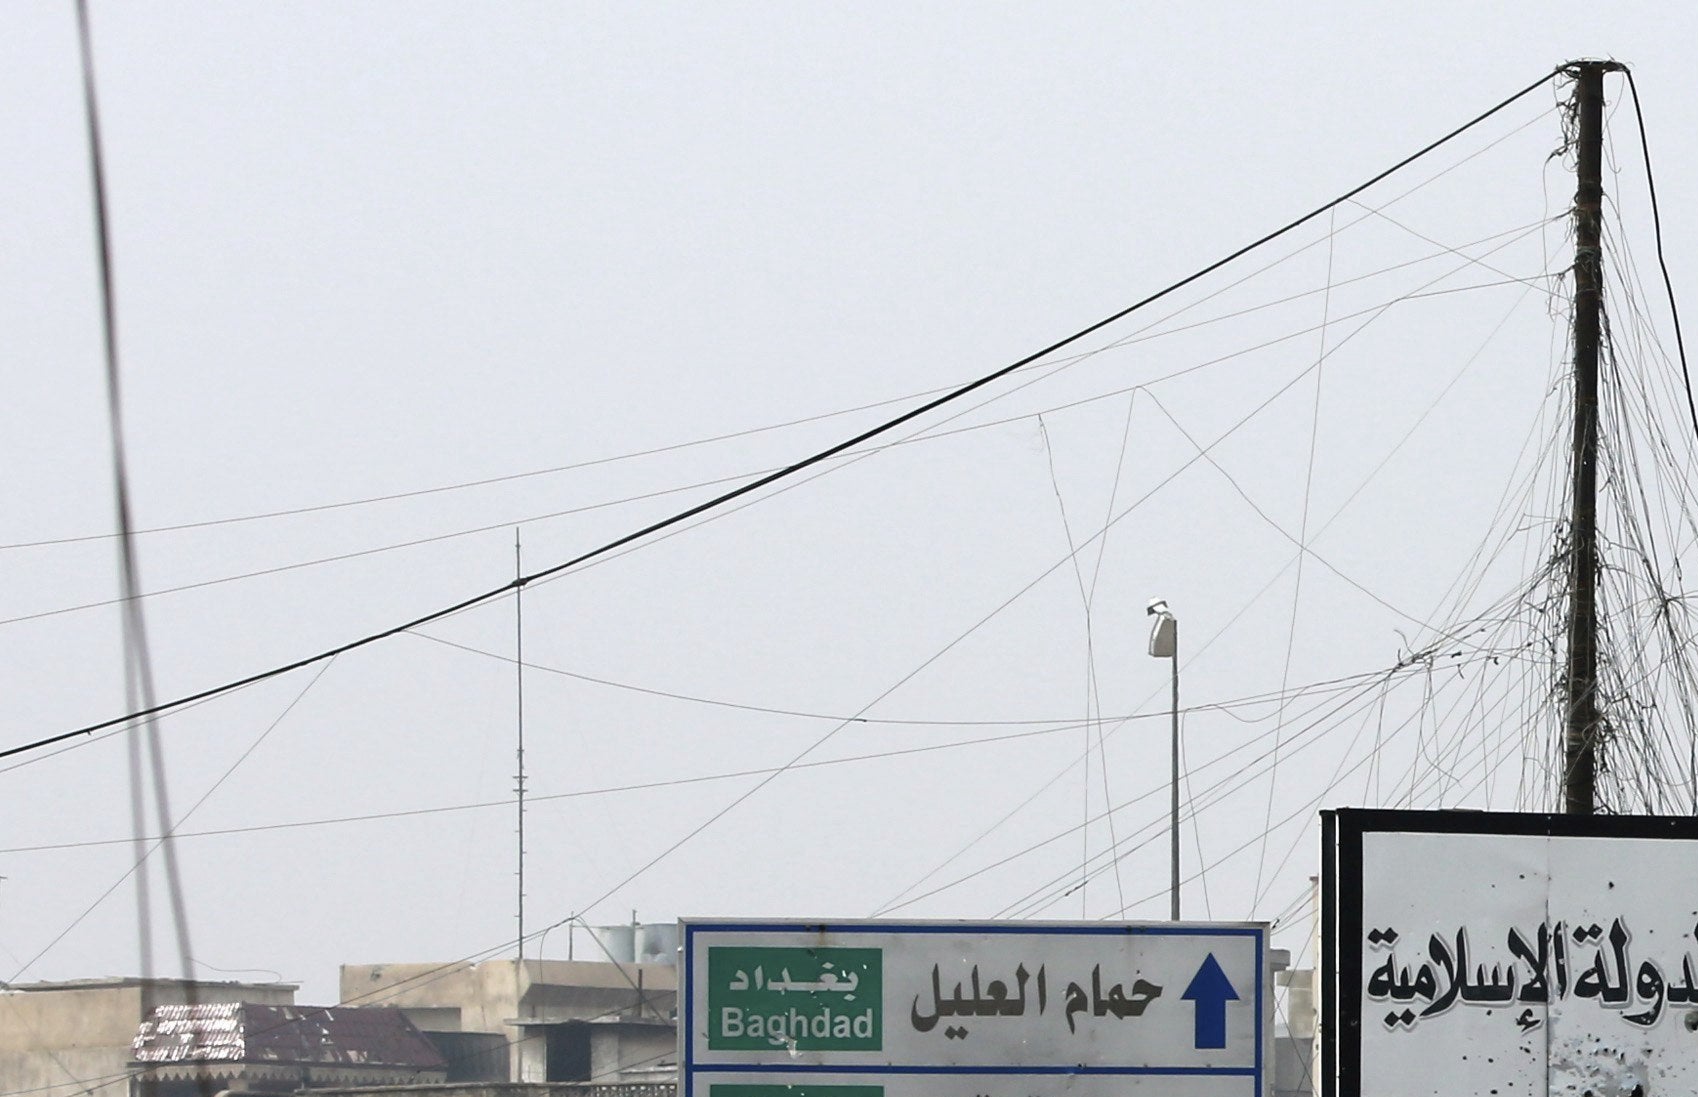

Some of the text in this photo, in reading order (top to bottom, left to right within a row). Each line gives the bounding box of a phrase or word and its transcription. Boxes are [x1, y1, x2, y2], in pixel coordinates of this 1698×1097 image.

[729, 962, 859, 1002] بغداد
[911, 962, 1164, 1040] حمام العليل
[1367, 920, 1569, 1034] الإسلامية
[721, 1007, 873, 1045] Baghdad
